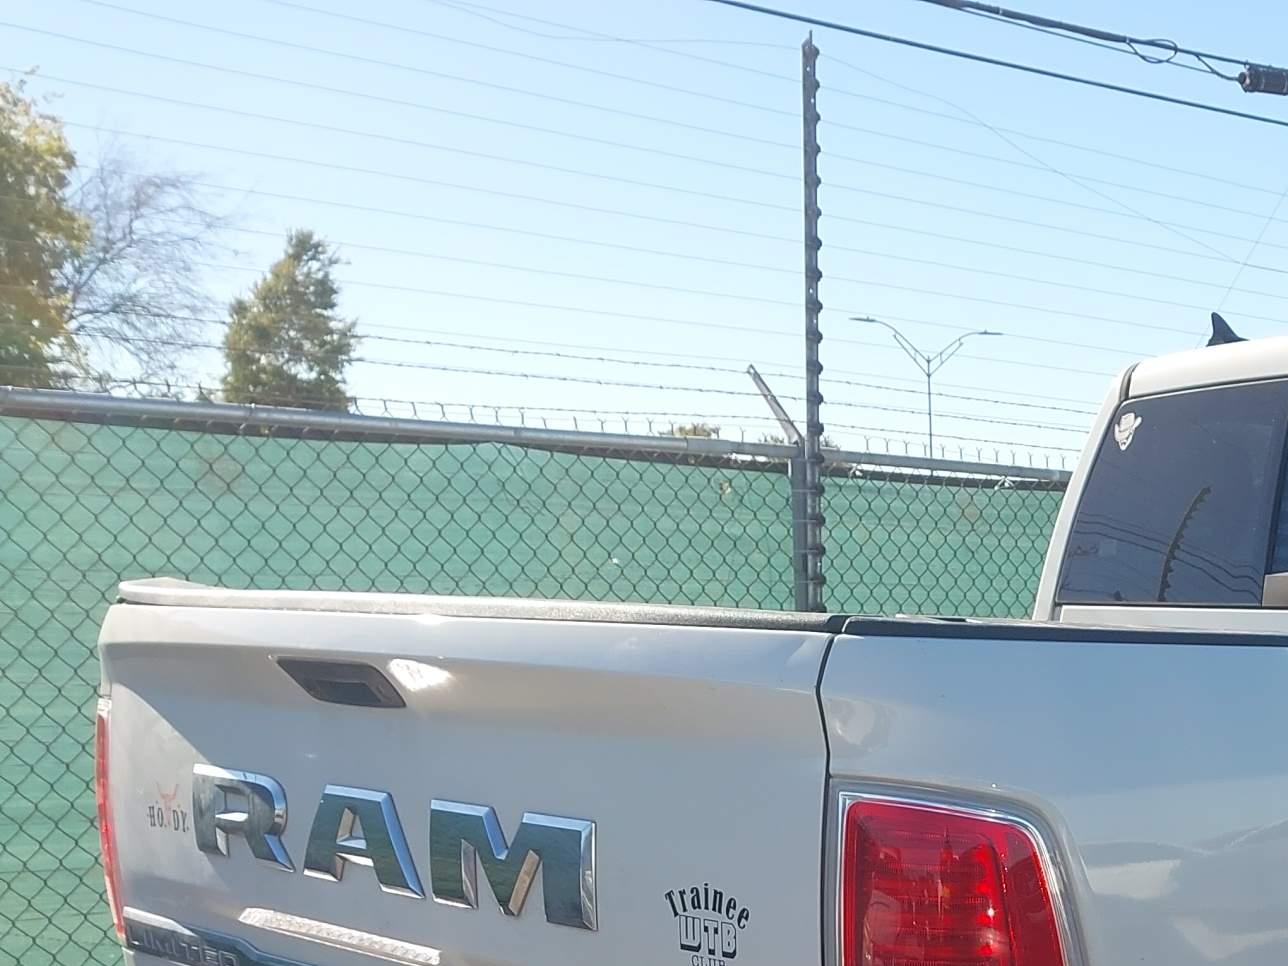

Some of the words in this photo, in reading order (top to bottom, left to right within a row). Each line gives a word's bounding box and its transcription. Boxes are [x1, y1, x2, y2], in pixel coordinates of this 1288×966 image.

[192, 763, 599, 931] RAM
[664, 883, 749, 930] Trainee
[679, 914, 737, 959] WTB
